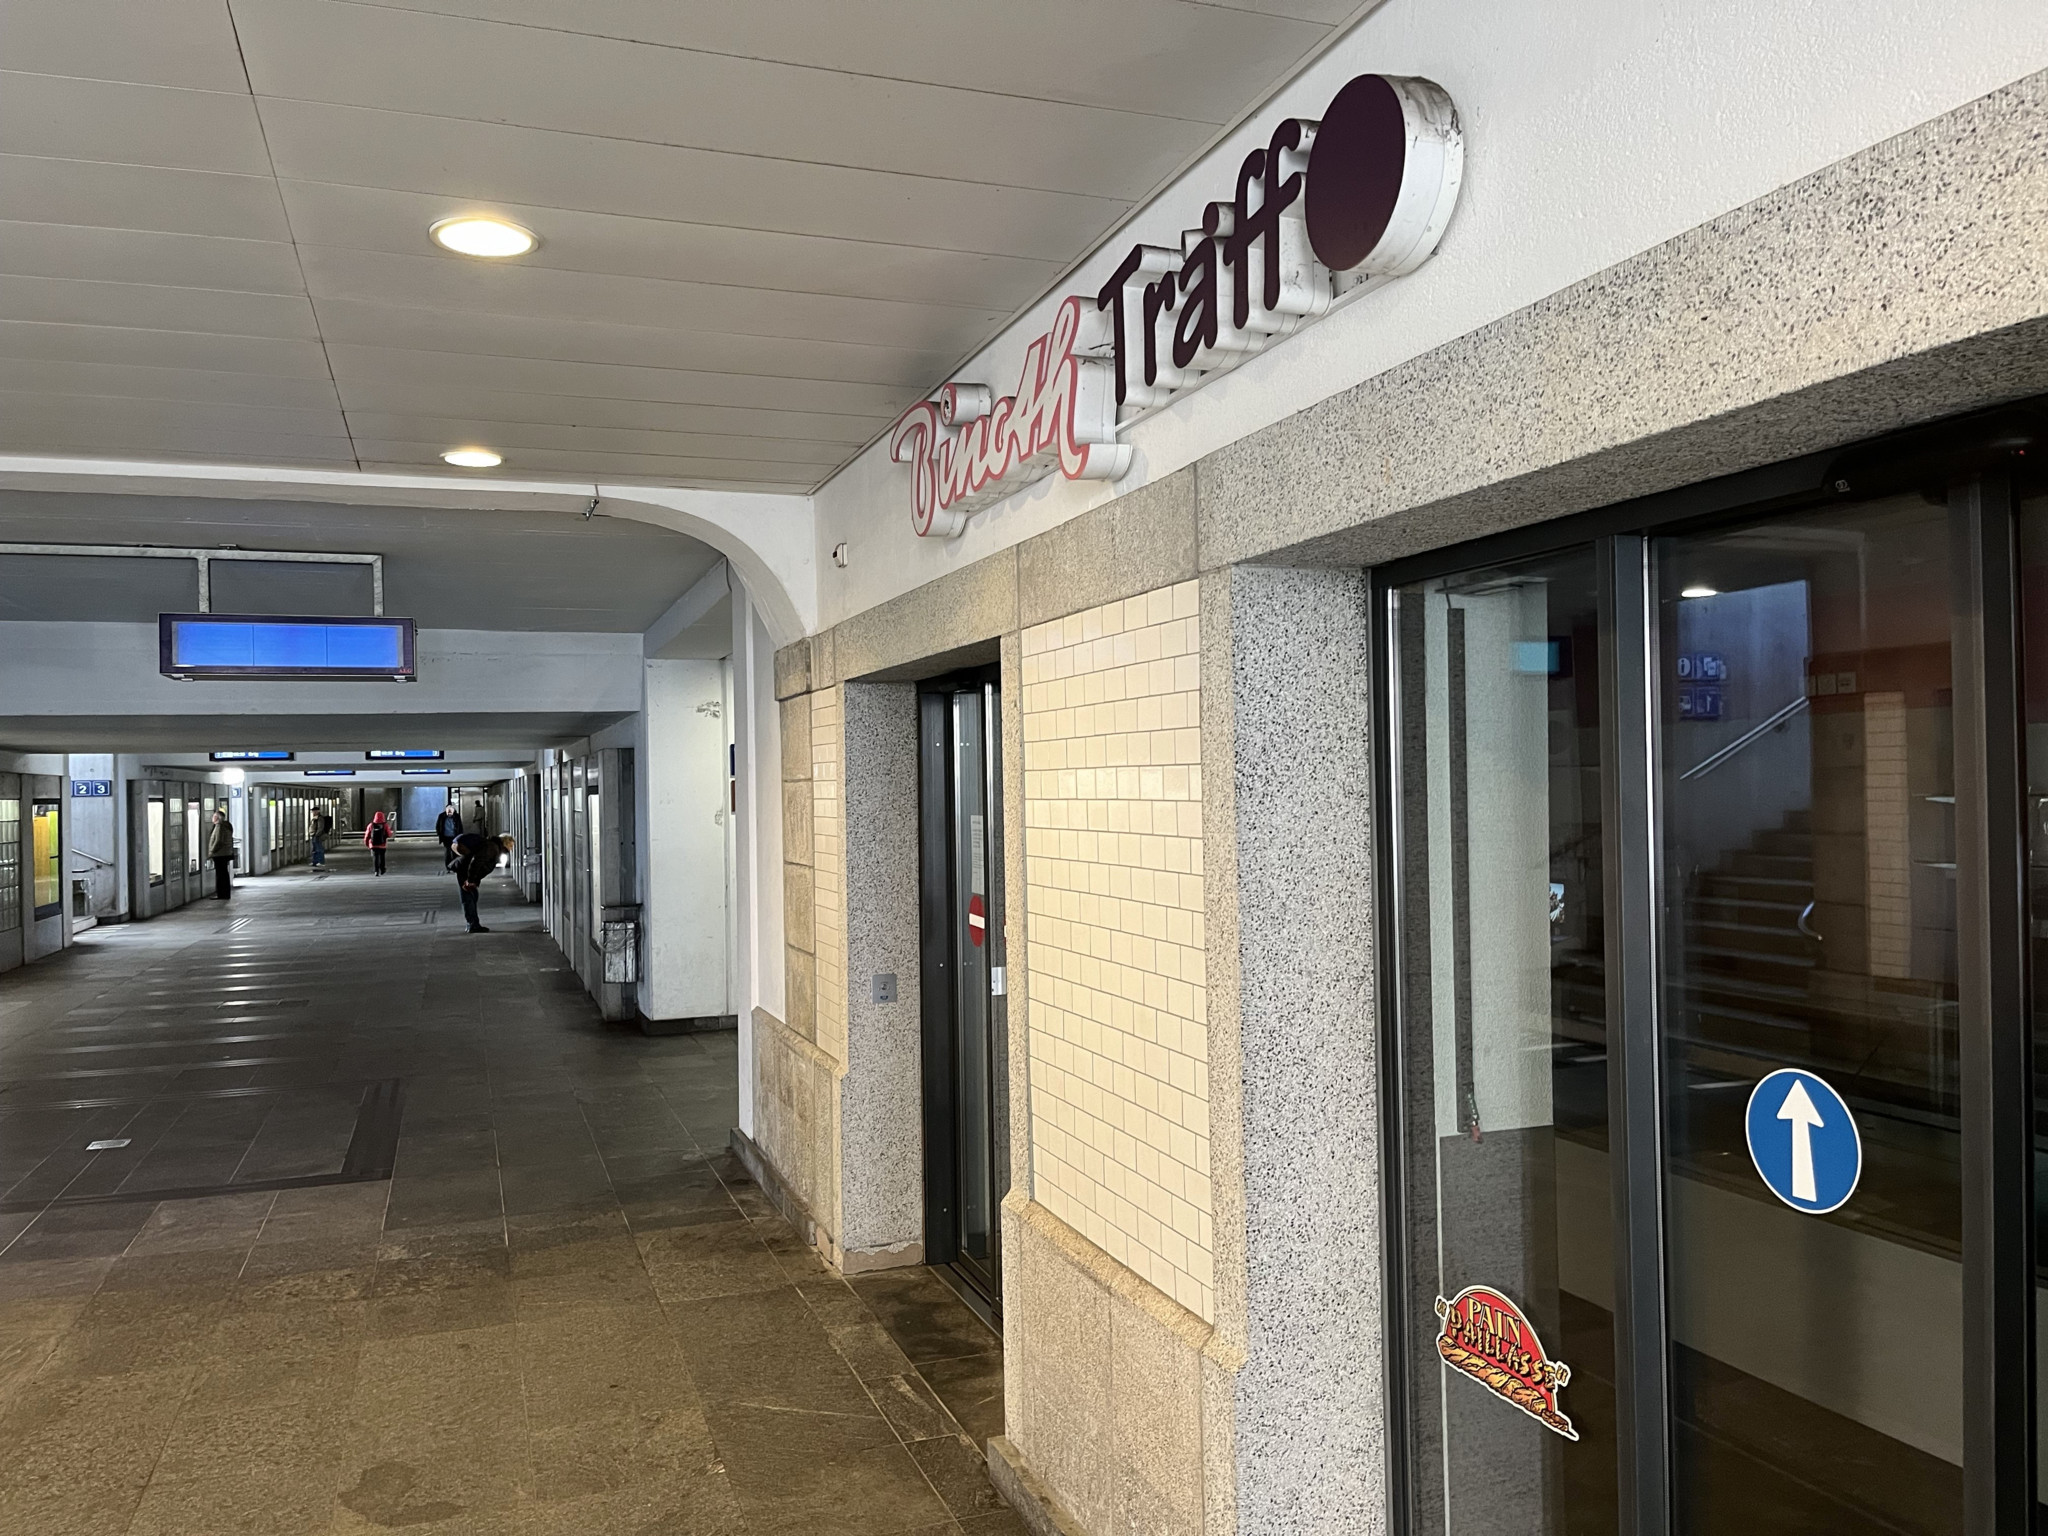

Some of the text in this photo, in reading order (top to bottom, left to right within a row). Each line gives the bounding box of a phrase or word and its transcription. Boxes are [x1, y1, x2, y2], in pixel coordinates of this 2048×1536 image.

[79, 785, 106, 794] 2 3
[1465, 1295, 1522, 1350] PAIN
